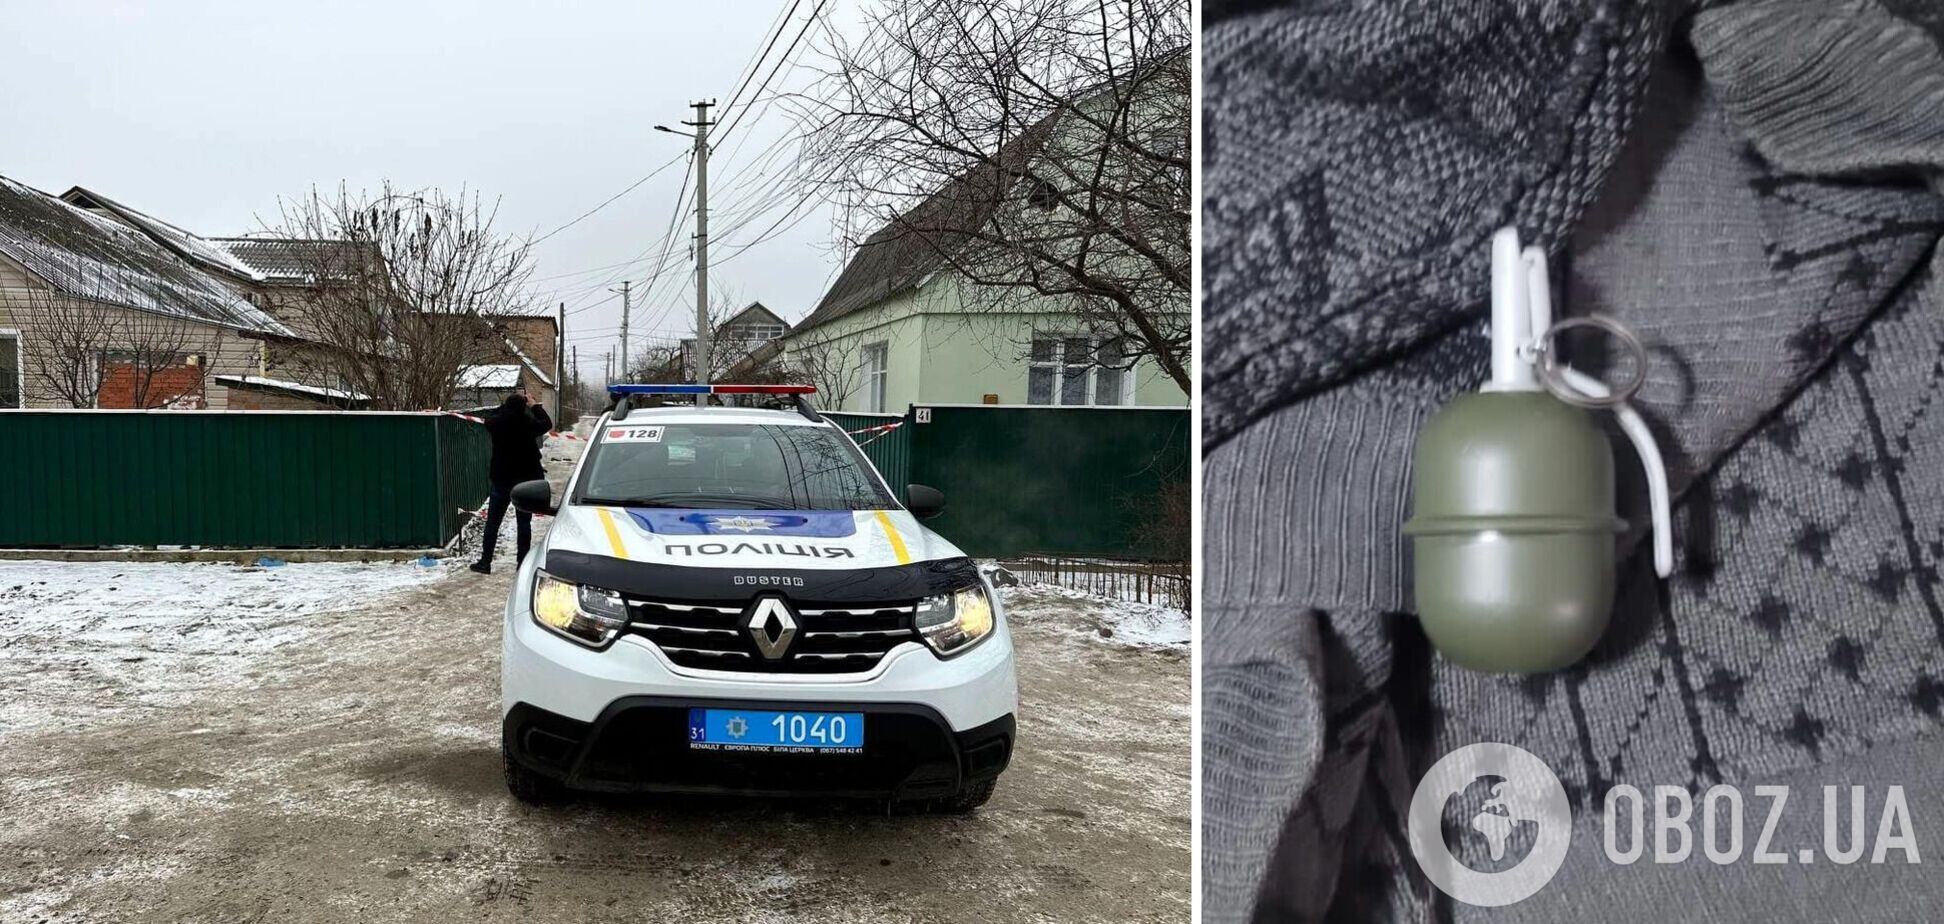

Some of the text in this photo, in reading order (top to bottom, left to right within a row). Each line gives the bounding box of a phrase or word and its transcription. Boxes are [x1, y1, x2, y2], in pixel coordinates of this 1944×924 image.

[918, 410, 929, 421] 41
[628, 429, 658, 438] 128
[665, 543, 855, 558] ПОЛІЦІЯ
[733, 575, 804, 587] DUSTER
[690, 727, 704, 739] 31
[772, 714, 846, 743] 1040
